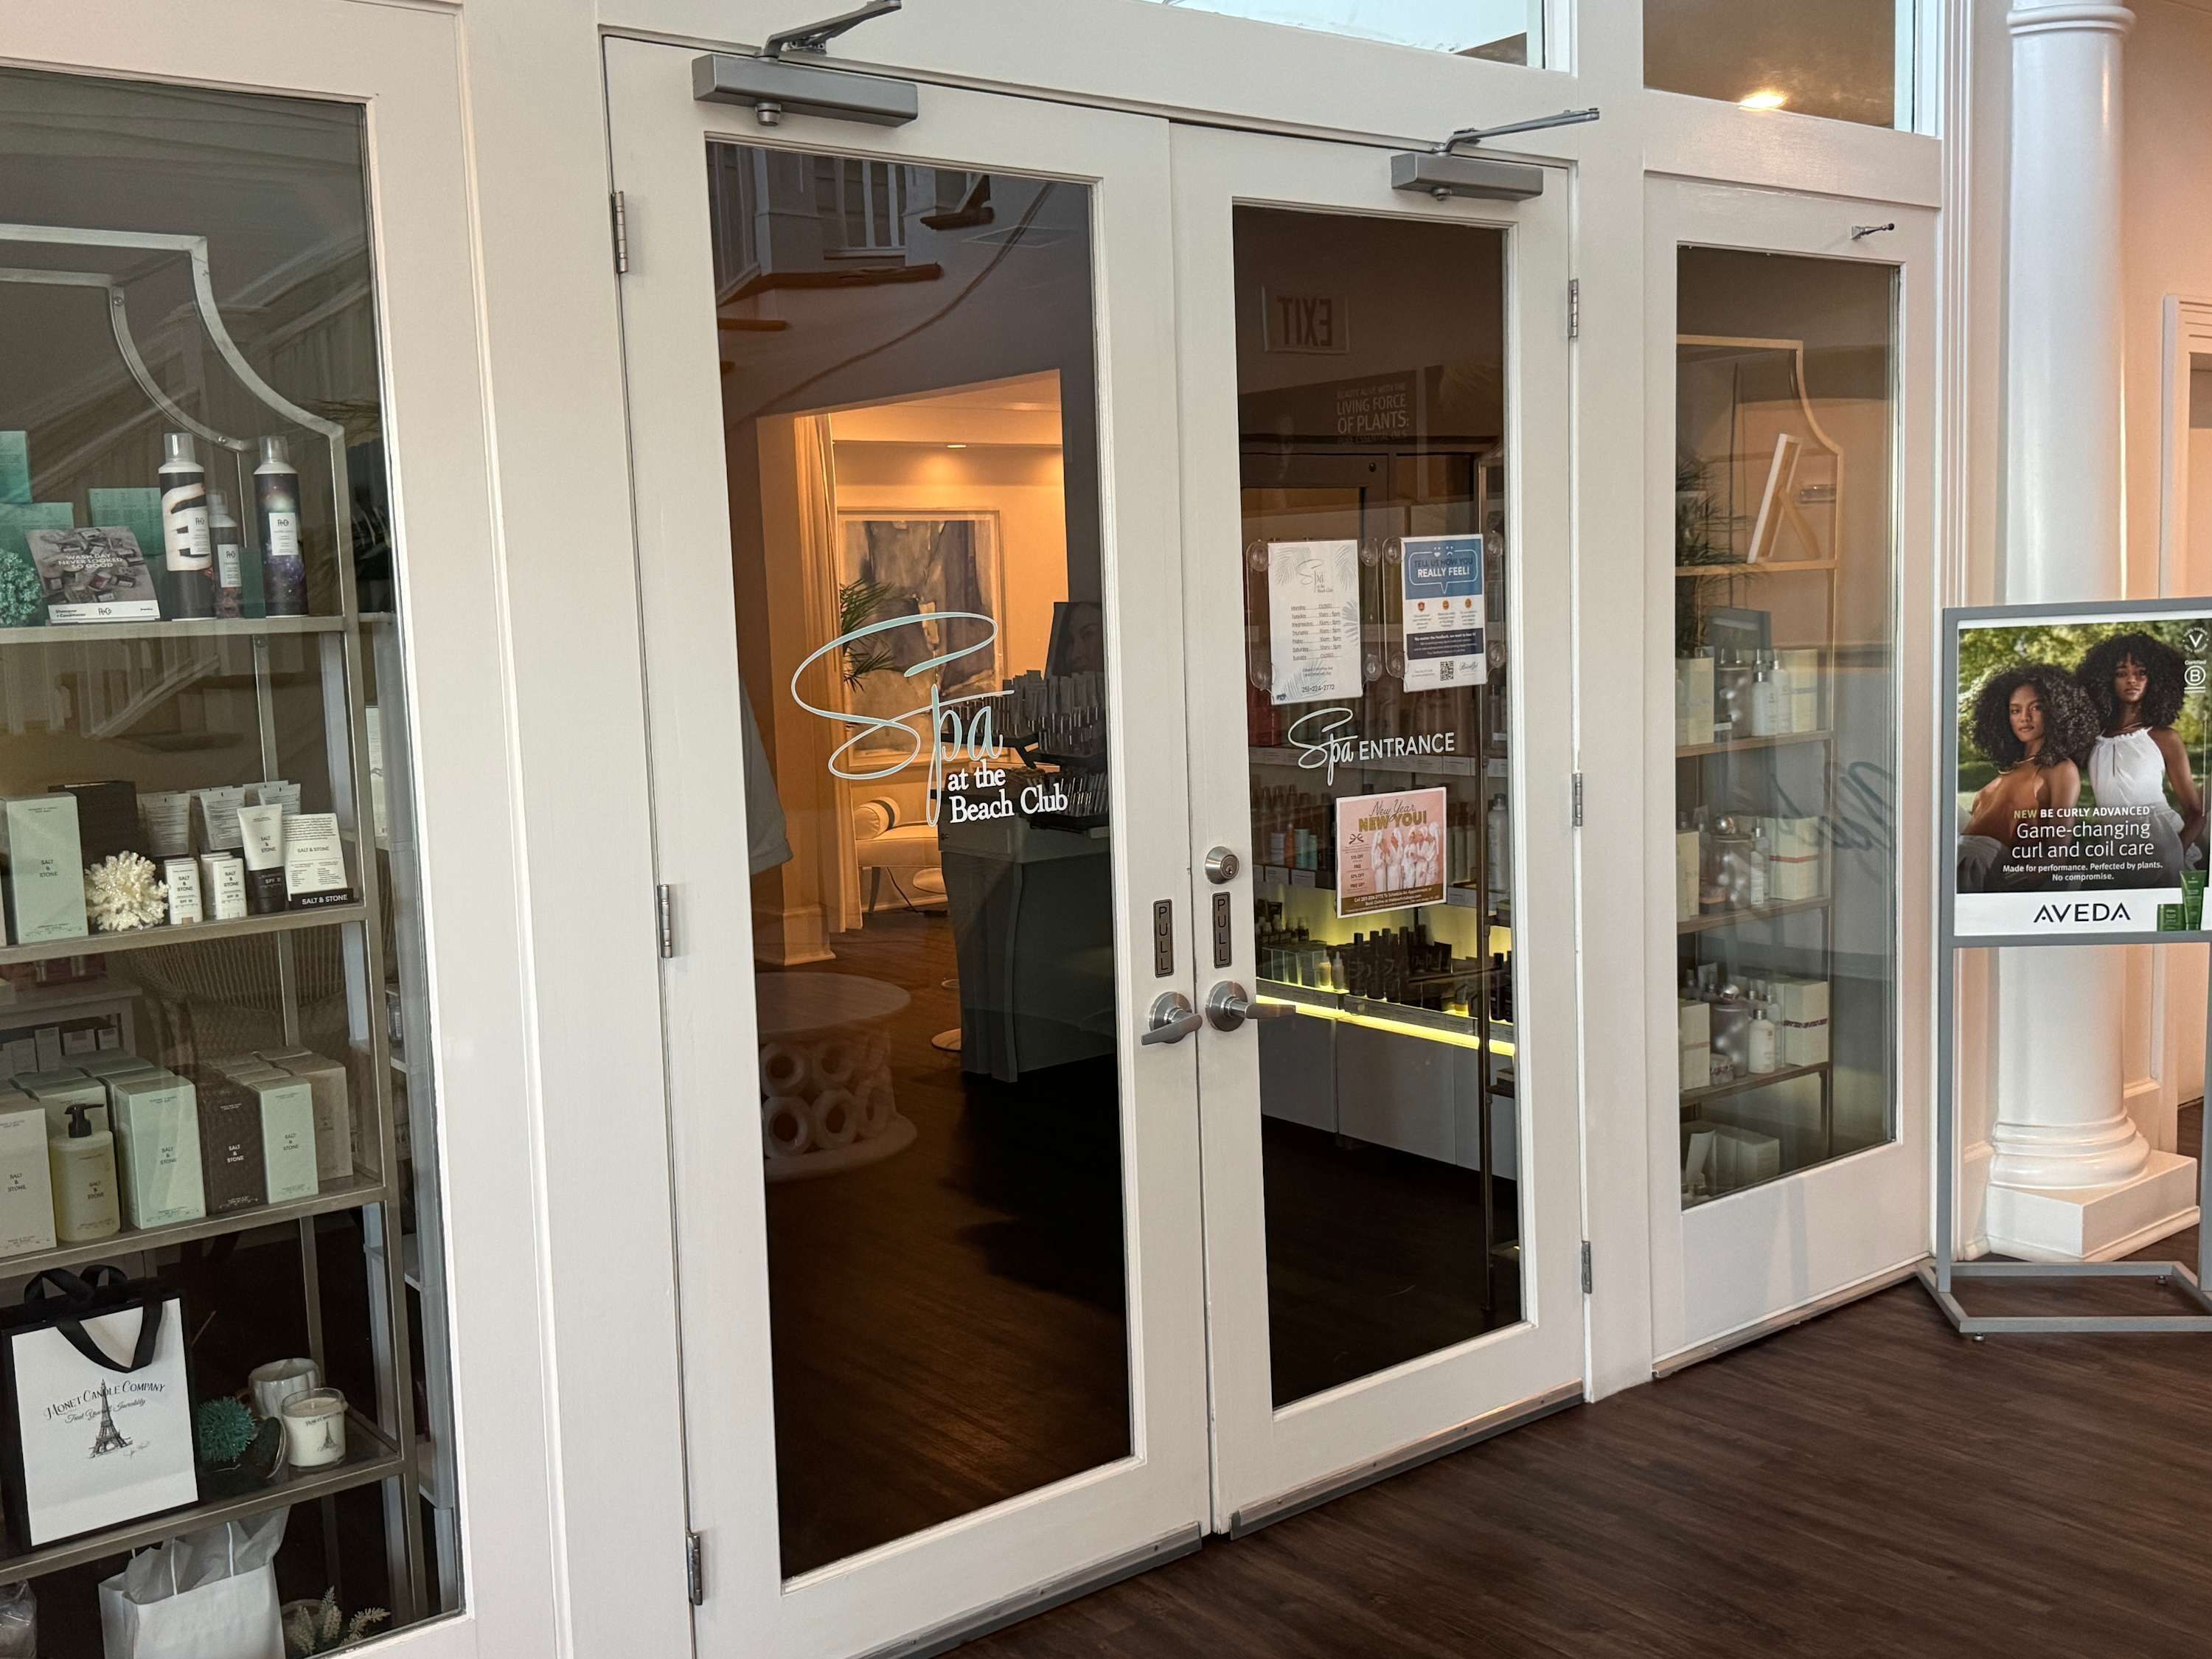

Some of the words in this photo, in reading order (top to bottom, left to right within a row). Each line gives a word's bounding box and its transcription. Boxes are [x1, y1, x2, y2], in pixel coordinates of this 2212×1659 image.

[1337, 398, 1370, 415] LIVING
[1373, 393, 1407, 410] FORCE
[1338, 417, 1355, 434] OF
[1357, 411, 1409, 433] PLANTS:
[1417, 568, 1446, 578] REALLY
[1448, 566, 1470, 576] FEEL!
[1441, 557, 1458, 566] HOW
[1460, 557, 1473, 566] YOU
[791, 612, 1015, 827] Spa
[1288, 707, 1358, 786] Spa
[1360, 732, 1455, 761] ENTRANCE
[947, 771, 970, 792] at
[975, 759, 1006, 789] the
[950, 786, 1015, 824] Beach
[1020, 784, 1068, 814] Club
[1369, 801, 1391, 816] New
[2014, 810, 2037, 818] NEW
[2040, 809, 2053, 818] BE
[2056, 808, 2090, 818] CURLY
[1359, 815, 1389, 832] NEW
[1394, 810, 1427, 827] YOU!
[2017, 821, 2151, 839] Game-changing
[2011, 842, 2043, 858] curl
[2048, 841, 2079, 858] and
[2085, 841, 2114, 857] coil
[2119, 843, 2154, 856] care
[2038, 863, 2088, 873] performance.
[2090, 863, 2125, 871] Perfected
[2126, 862, 2135, 871] by
[2138, 861, 2163, 871] plants.
[2065, 872, 2114, 883] compromise.
[326, 894, 348, 902] STONE
[2033, 902, 2131, 923] AVEDA
[1158, 906, 1169, 970] PULL
[1217, 898, 1228, 961] PULL
